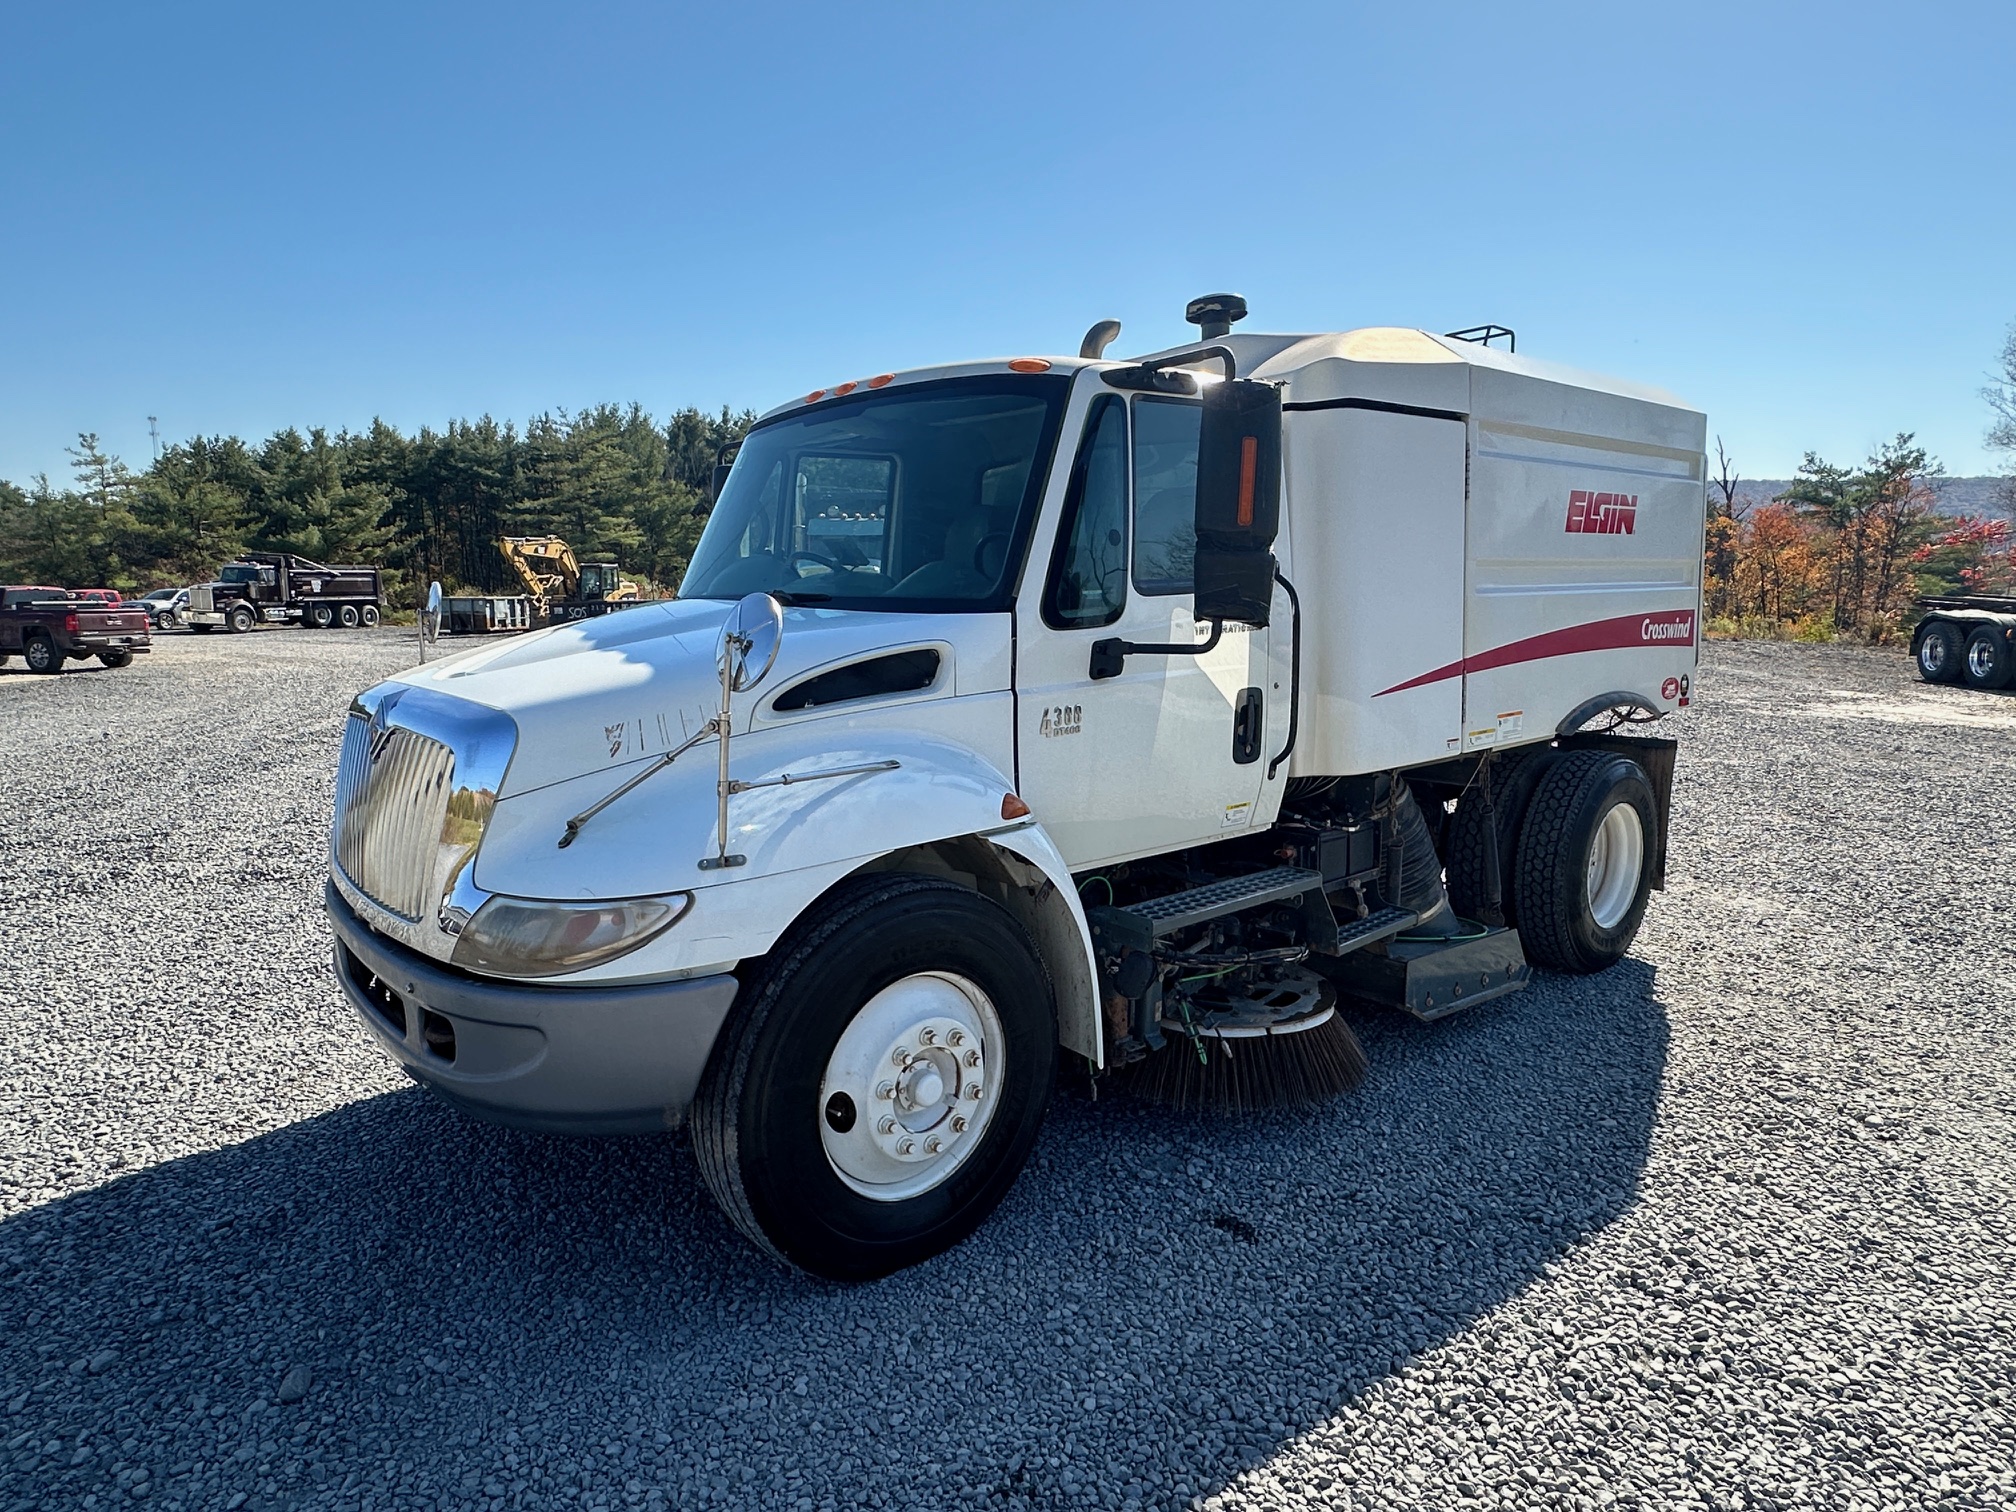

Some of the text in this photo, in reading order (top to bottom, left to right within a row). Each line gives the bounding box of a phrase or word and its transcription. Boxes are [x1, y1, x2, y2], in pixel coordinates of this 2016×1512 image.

[1565, 489, 1638, 535] ELGIN
[1641, 617, 1692, 640] Crosswind
[1039, 704, 1082, 738] 4300
